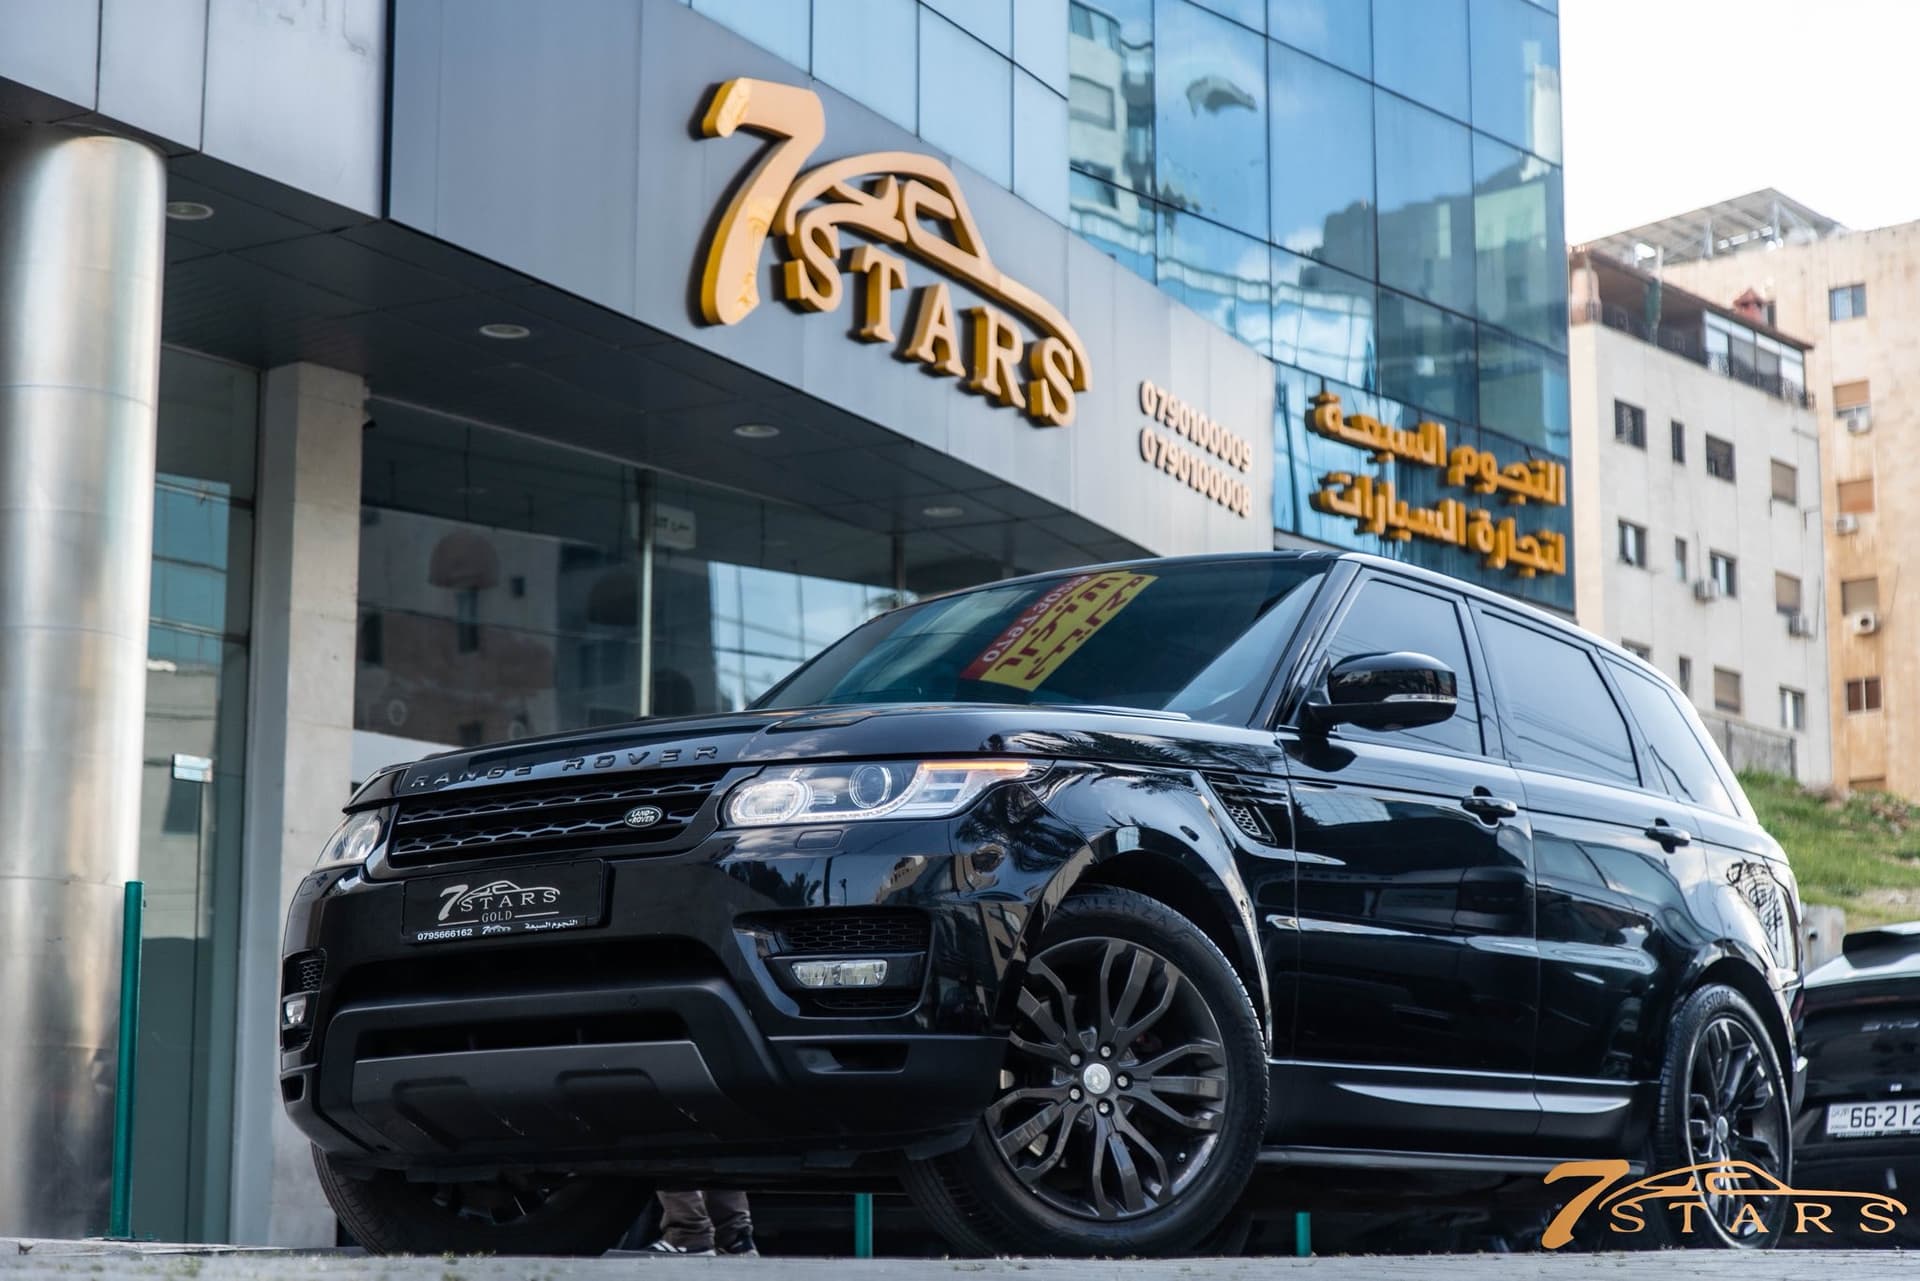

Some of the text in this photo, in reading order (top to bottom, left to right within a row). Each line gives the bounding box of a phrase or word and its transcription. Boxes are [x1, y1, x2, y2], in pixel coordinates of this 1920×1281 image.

[785, 221, 1077, 427] STARS
[1139, 380, 1252, 473] 0790100009
[1313, 392, 1566, 506] النجوم السبعة
[1317, 471, 1566, 578] لتجارة السيارات
[411, 745, 718, 788] RANGE ROVER
[631, 810, 650, 818] LAND
[631, 815, 655, 824] ROVER
[460, 890, 558, 912] STARS
[481, 910, 513, 924] GOLD
[417, 928, 473, 941] 0795666162
